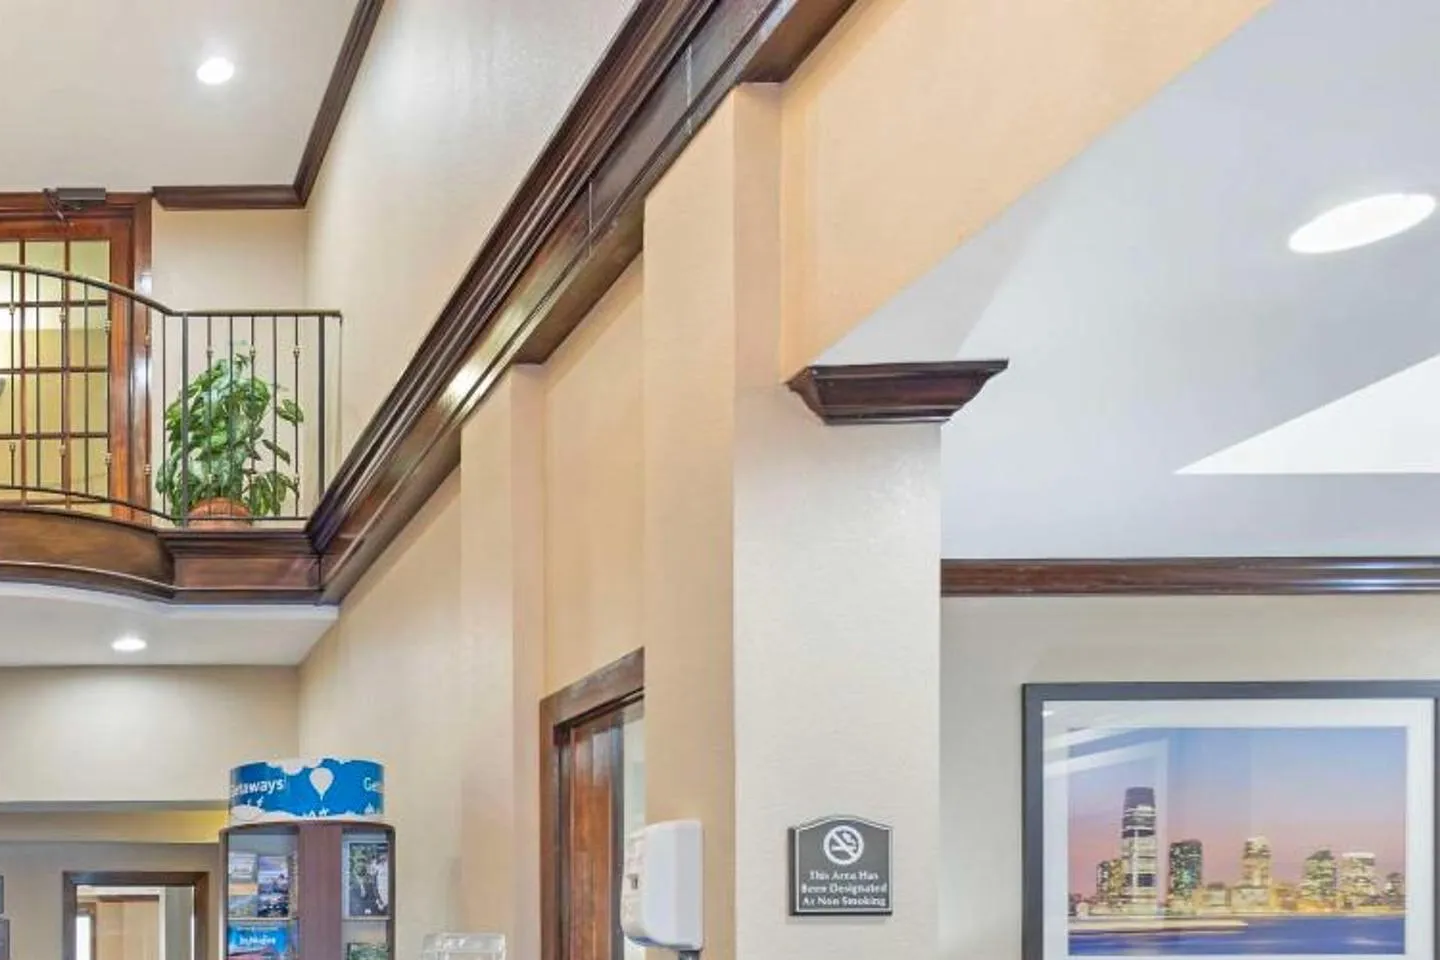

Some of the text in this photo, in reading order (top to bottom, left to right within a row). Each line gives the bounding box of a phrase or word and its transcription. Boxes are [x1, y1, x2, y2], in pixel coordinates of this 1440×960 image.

[809, 870, 879, 880] This Area Has
[800, 882, 888, 896] Been Designated
[818, 896, 840, 906] Non
[842, 896, 887, 908] Smoking
